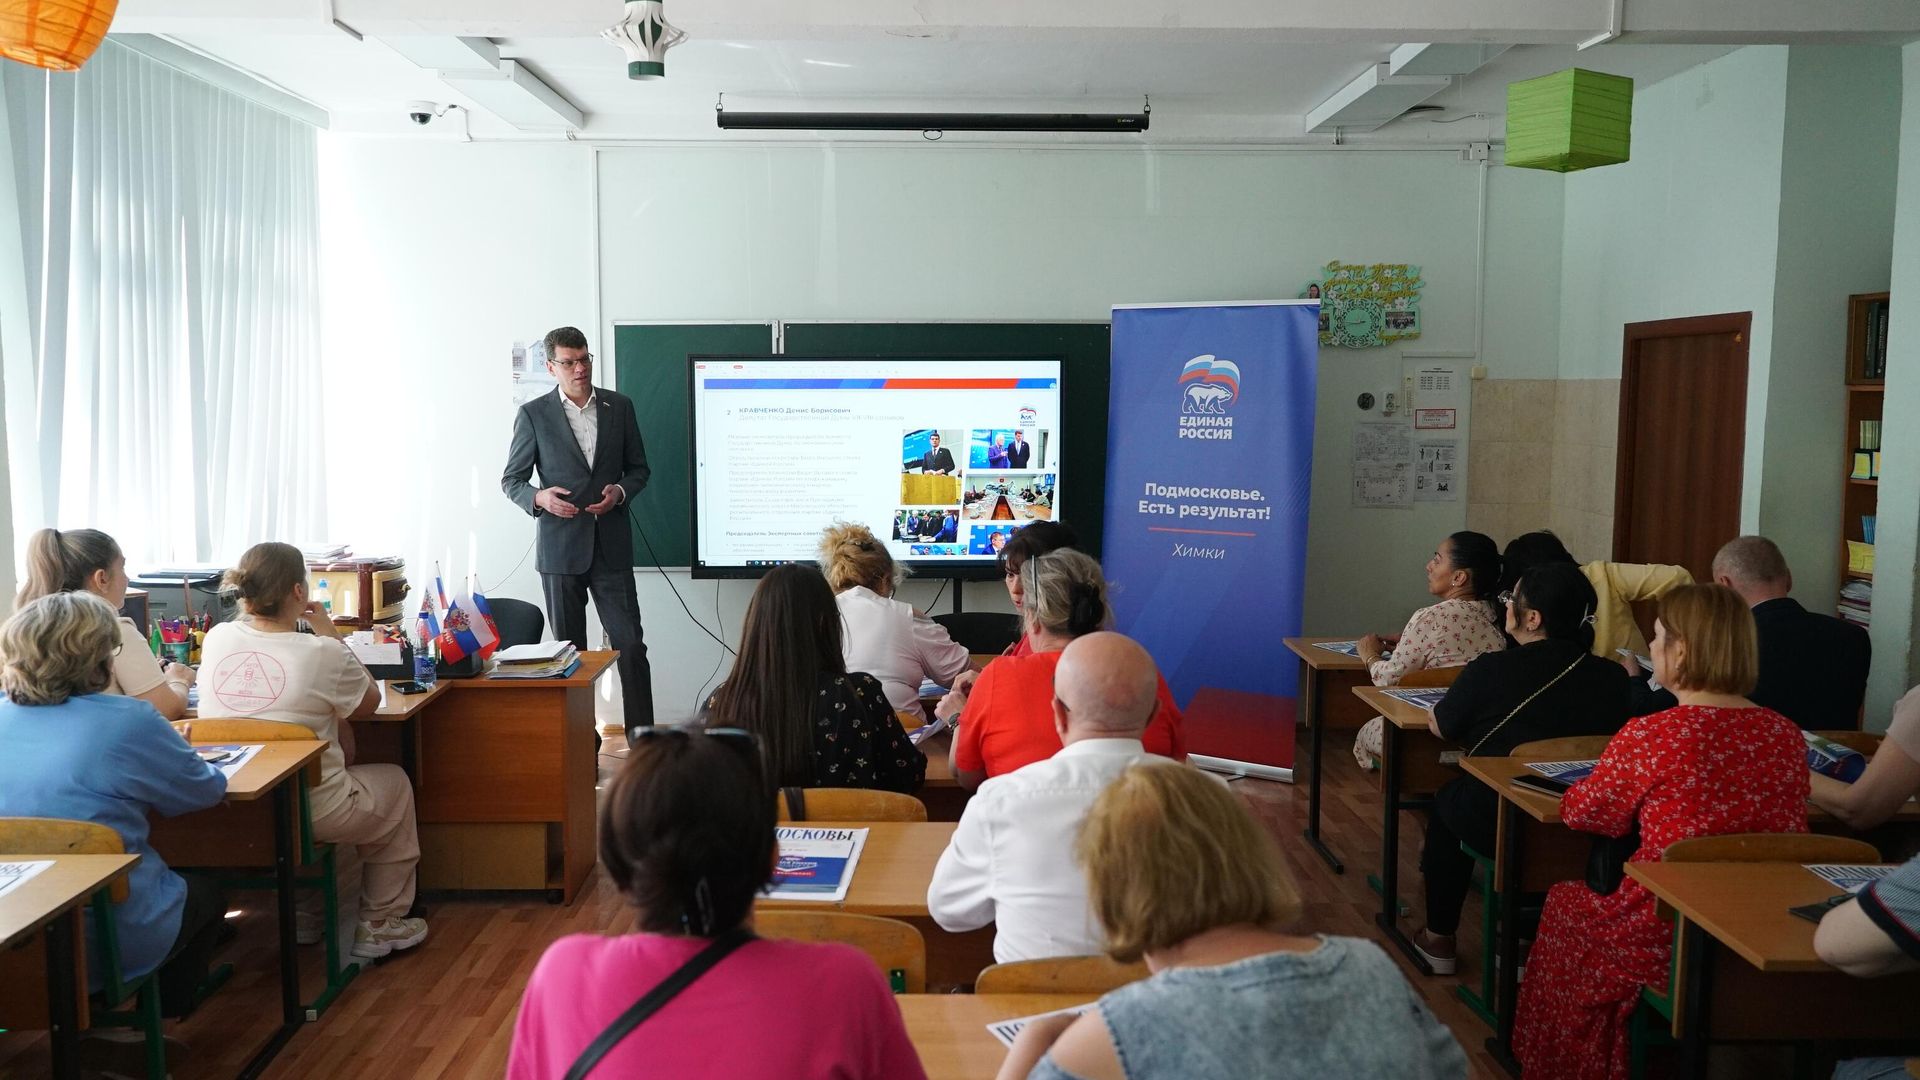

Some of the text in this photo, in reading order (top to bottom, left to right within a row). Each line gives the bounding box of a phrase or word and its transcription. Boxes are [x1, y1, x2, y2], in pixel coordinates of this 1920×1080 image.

[810, 407, 851, 415] Борисович
[1180, 416, 1233, 427] ЕДИНАЯ
[1179, 428, 1233, 440] РОССИЯ
[1145, 482, 1265, 501] Подмосковье.
[1138, 500, 1271, 520] Есть результат!
[1172, 543, 1225, 560] Химки
